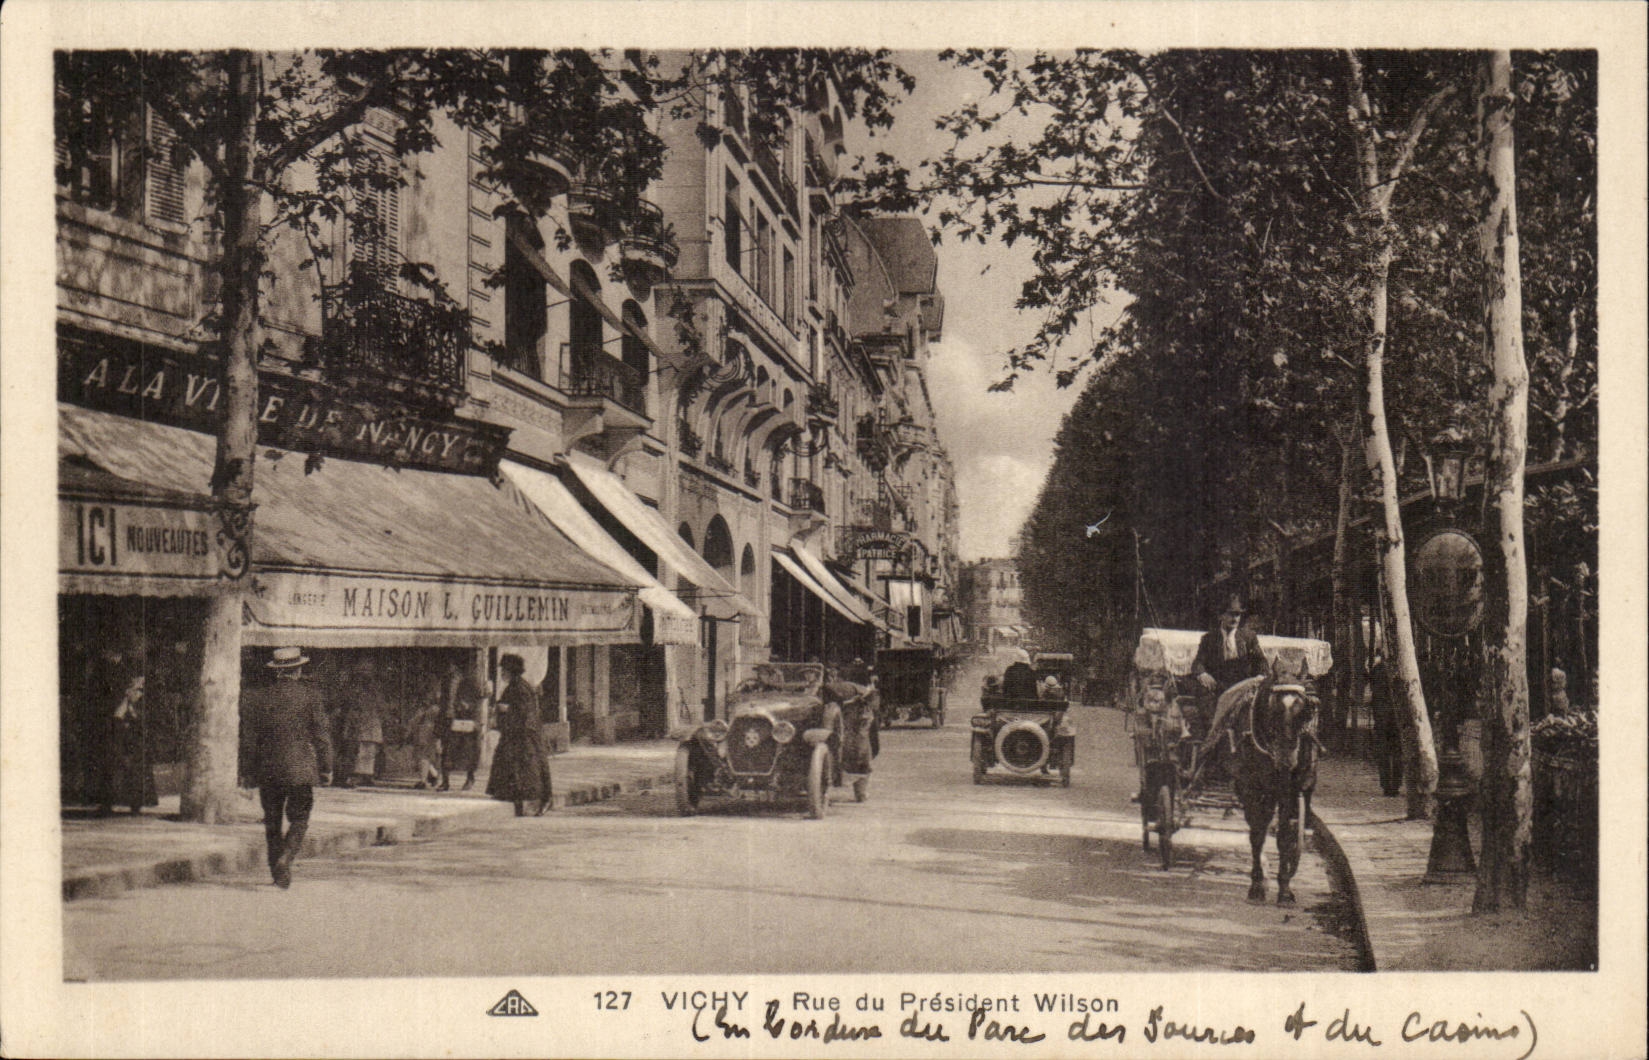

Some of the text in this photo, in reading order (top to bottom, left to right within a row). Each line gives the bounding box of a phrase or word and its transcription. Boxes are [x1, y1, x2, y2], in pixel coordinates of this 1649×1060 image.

[84, 358, 108, 387] A
[117, 365, 164, 399] LA
[184, 373, 285, 423] VIE
[77, 504, 209, 566] ICI NOUVEAUTES
[343, 588, 428, 618] MAISON
[443, 592, 459, 620] L.
[472, 594, 569, 623] GUILLEMIN
[900, 1010, 950, 1041] du
[967, 1008, 1045, 1043] Parc
[1325, 1008, 1382, 1047] du
